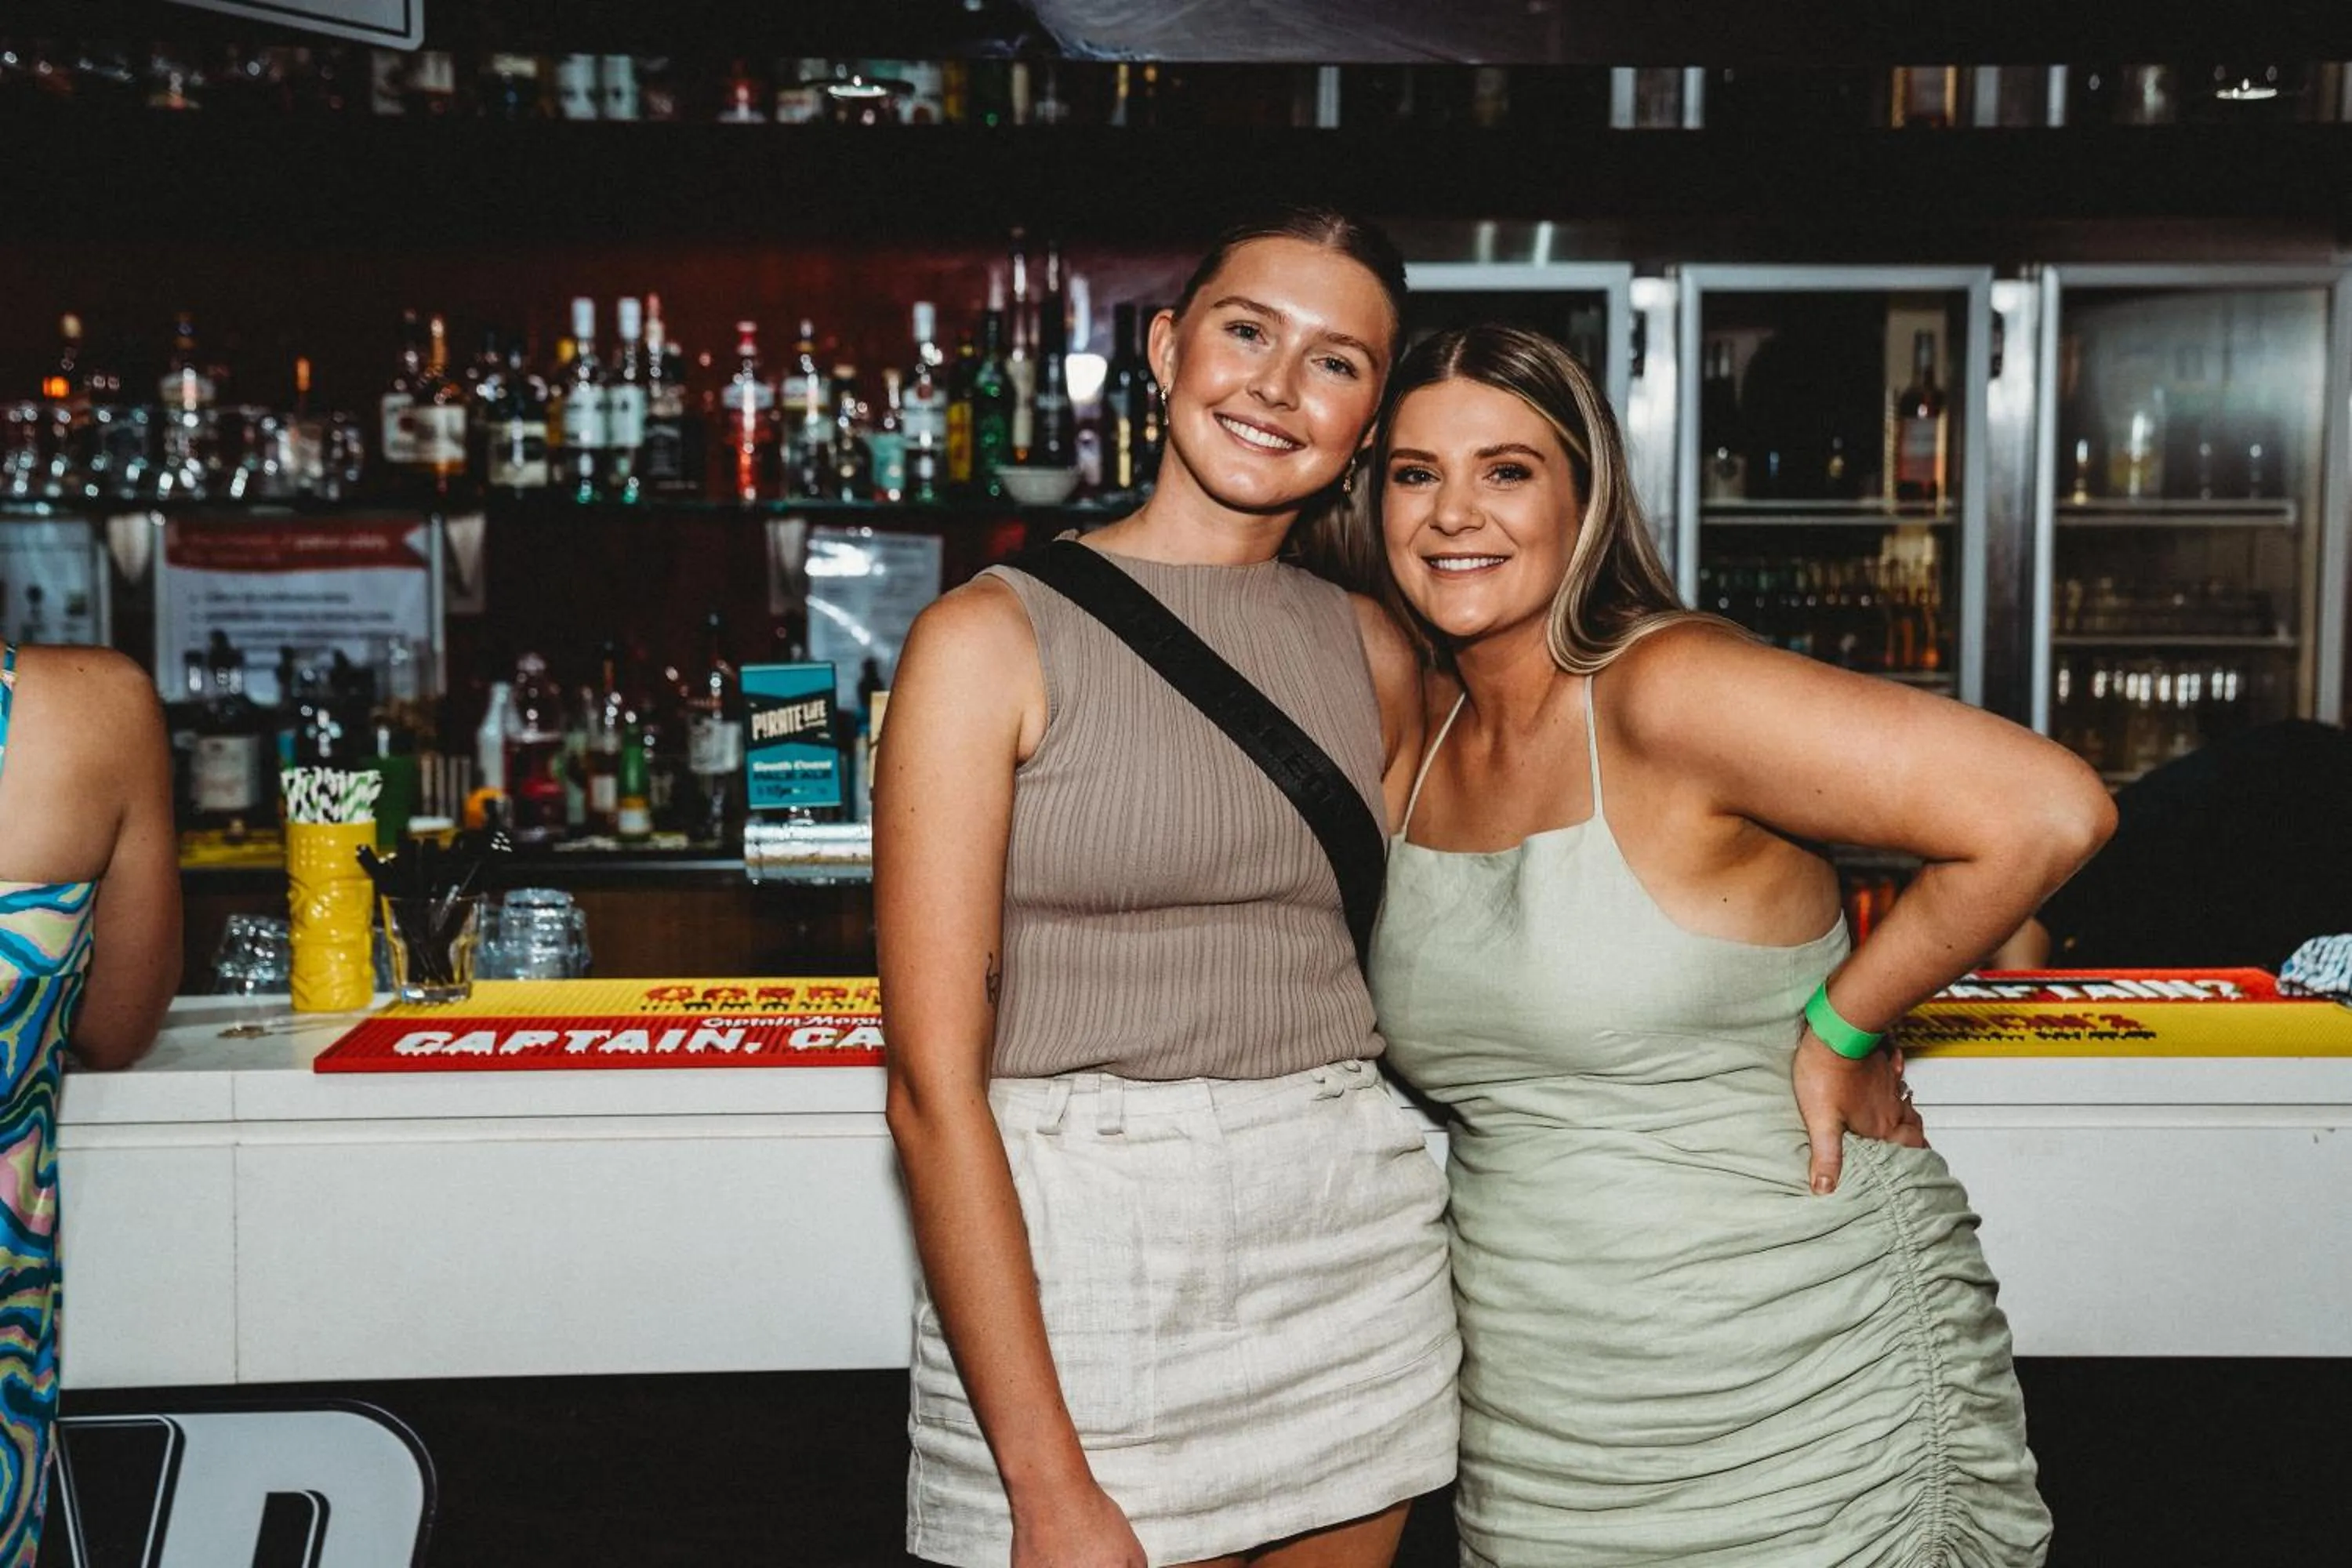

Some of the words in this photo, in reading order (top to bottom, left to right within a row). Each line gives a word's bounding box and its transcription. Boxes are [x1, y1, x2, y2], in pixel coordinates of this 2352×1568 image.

[752, 705, 804, 741] PIRATE
[702, 1017, 800, 1028] Captain
[393, 1029, 762, 1055] CAPTAIN.
[788, 1027, 885, 1052] CA
